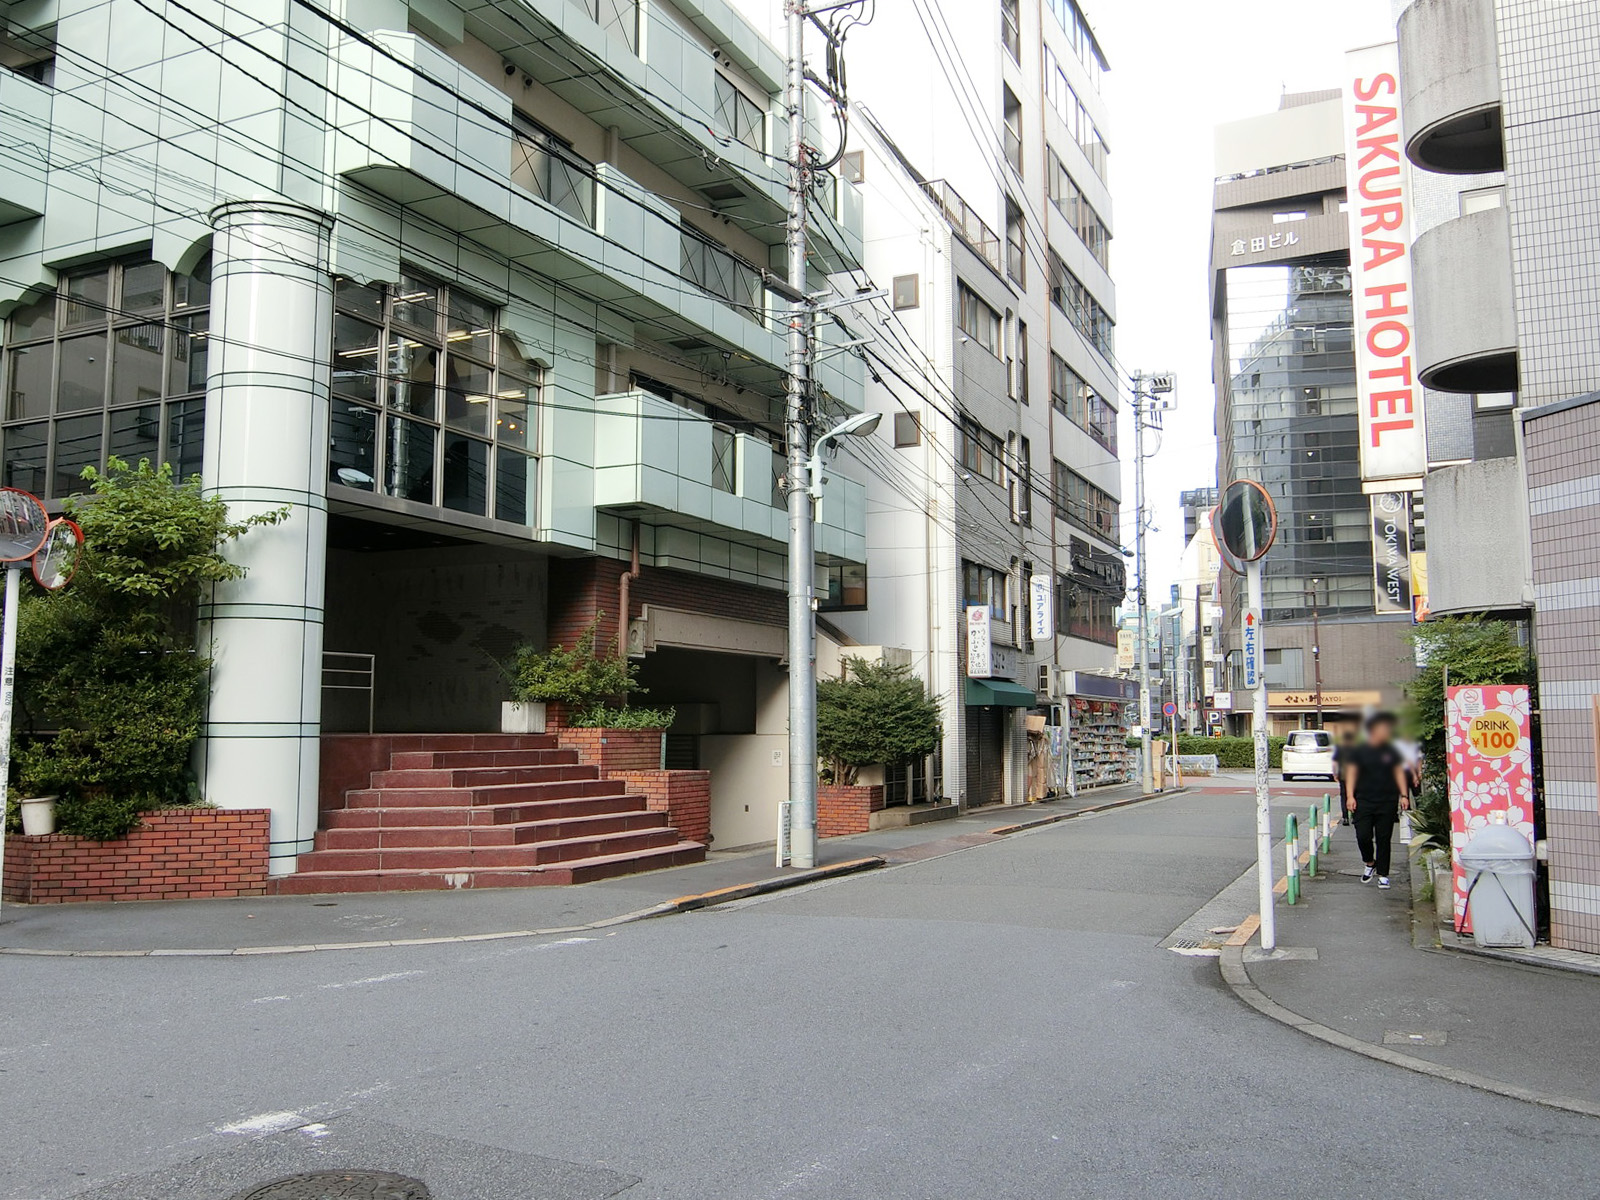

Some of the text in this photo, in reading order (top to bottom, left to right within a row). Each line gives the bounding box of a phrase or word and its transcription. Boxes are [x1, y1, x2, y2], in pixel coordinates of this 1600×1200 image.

[1230, 231, 1299, 256] 倉田ビル
[1353, 72, 1414, 448] SAKURA HOTEL
[1384, 516, 1400, 602] TOKIWA WEST
[1244, 626, 1256, 685] 左右確認
[1209, 712, 1219, 723] P
[1475, 720, 1510, 731] DRINK
[1472, 732, 1516, 749] ¥100
